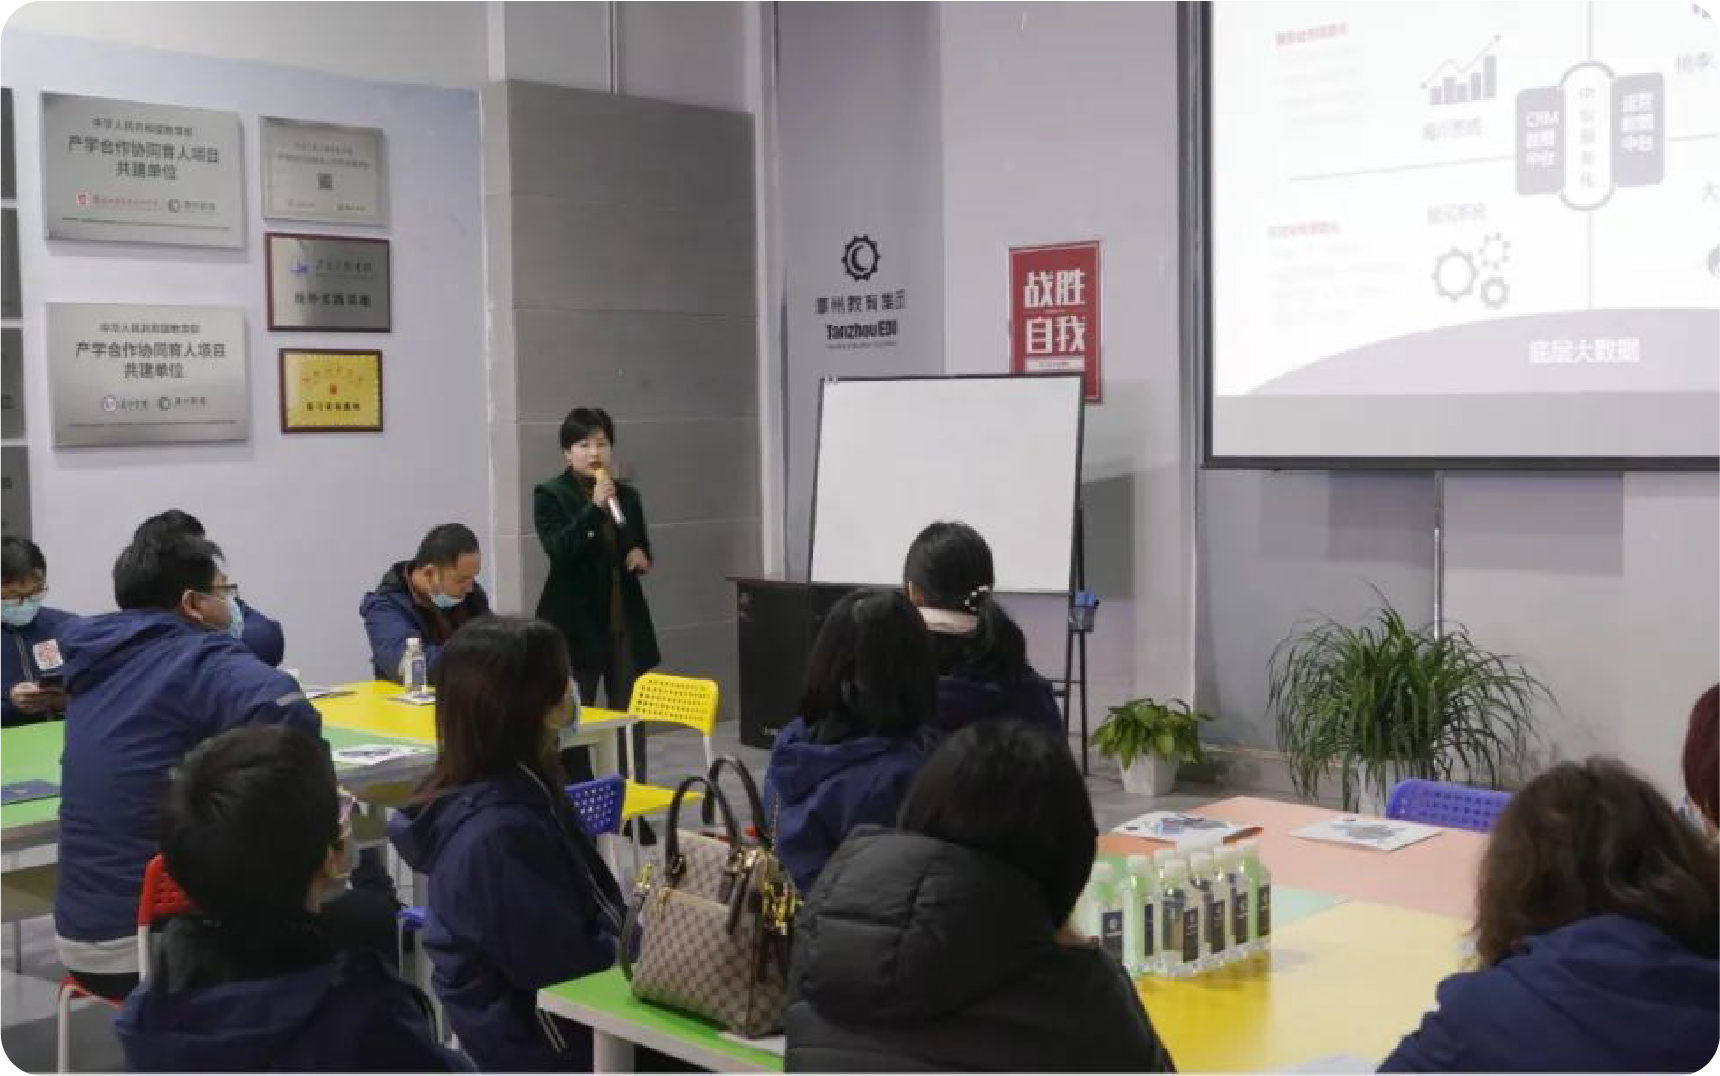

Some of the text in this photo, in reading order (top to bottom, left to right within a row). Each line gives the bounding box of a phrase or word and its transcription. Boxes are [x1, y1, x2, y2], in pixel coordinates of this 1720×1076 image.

[67, 134, 219, 165] 产学合作协同育人项目
[115, 159, 178, 181] 共建单位
[1024, 267, 1086, 308] 战胜
[1025, 314, 1085, 354] 自我
[75, 341, 226, 359] 产学合作协同育人项目
[123, 362, 185, 379] 共建单位
